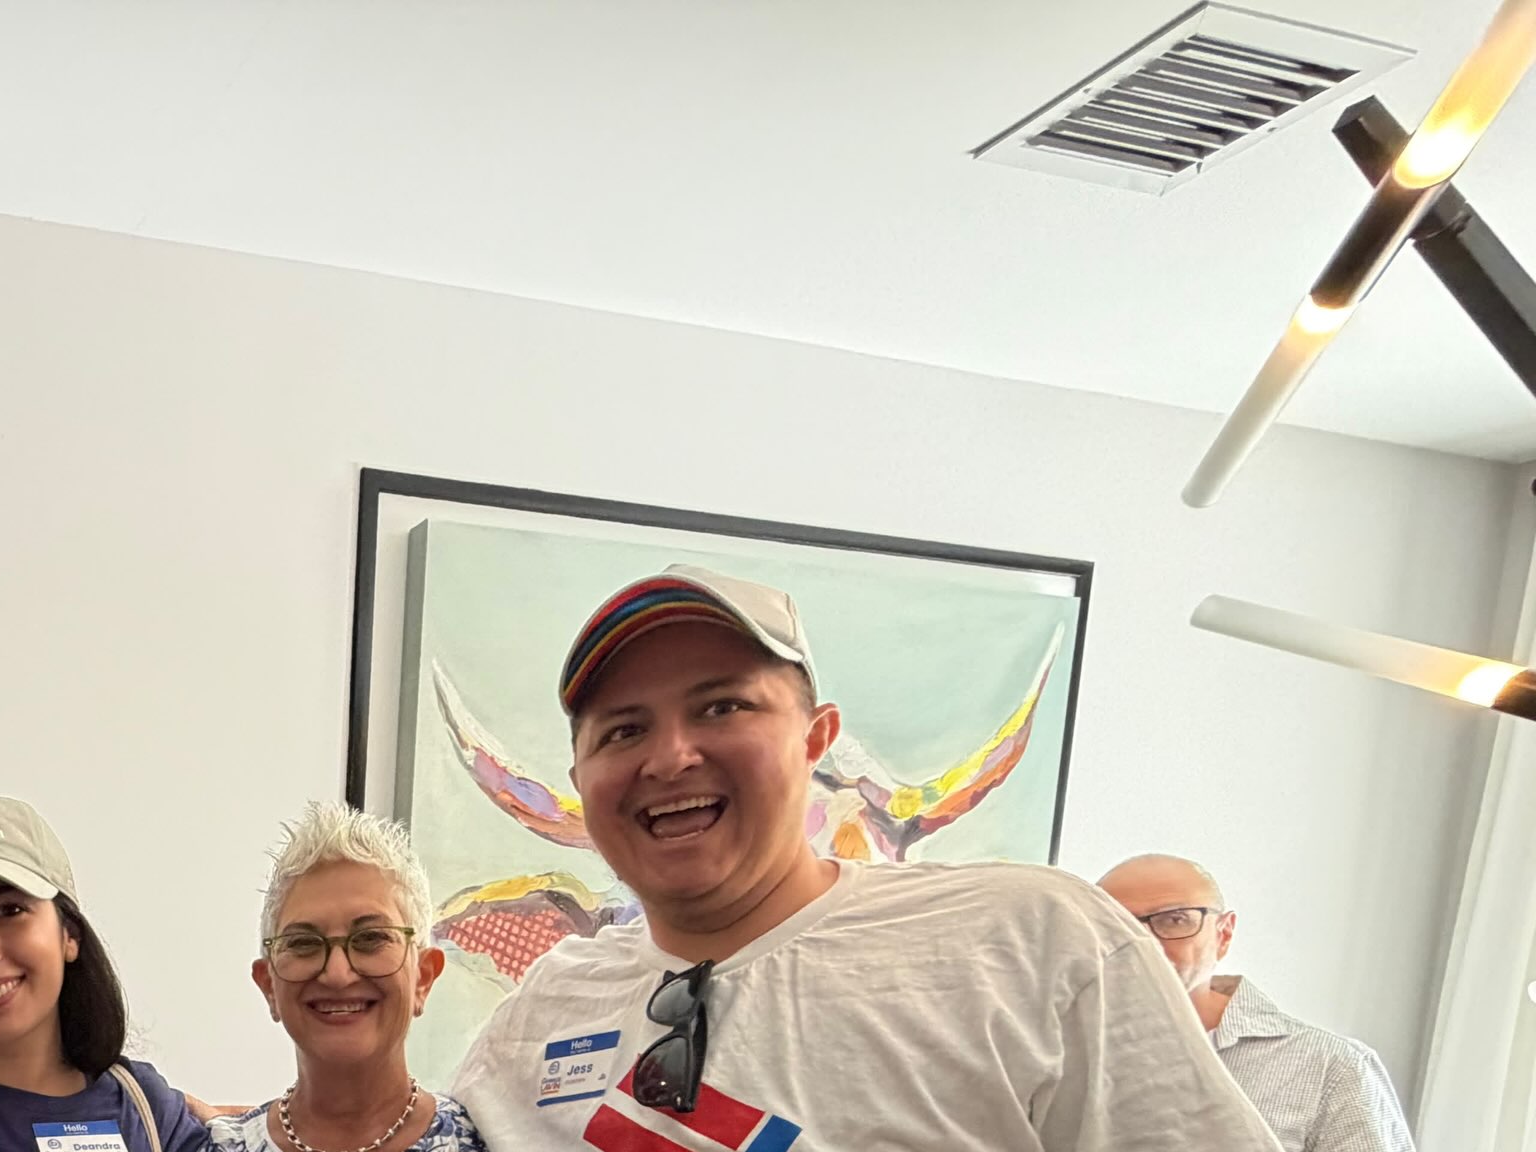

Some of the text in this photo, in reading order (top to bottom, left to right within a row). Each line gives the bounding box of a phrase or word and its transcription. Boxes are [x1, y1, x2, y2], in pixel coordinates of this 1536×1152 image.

[570, 1038, 593, 1050] Hello
[567, 1063, 594, 1076] Jess
[63, 1123, 89, 1133] Hello
[73, 1142, 121, 1152] Deandra
